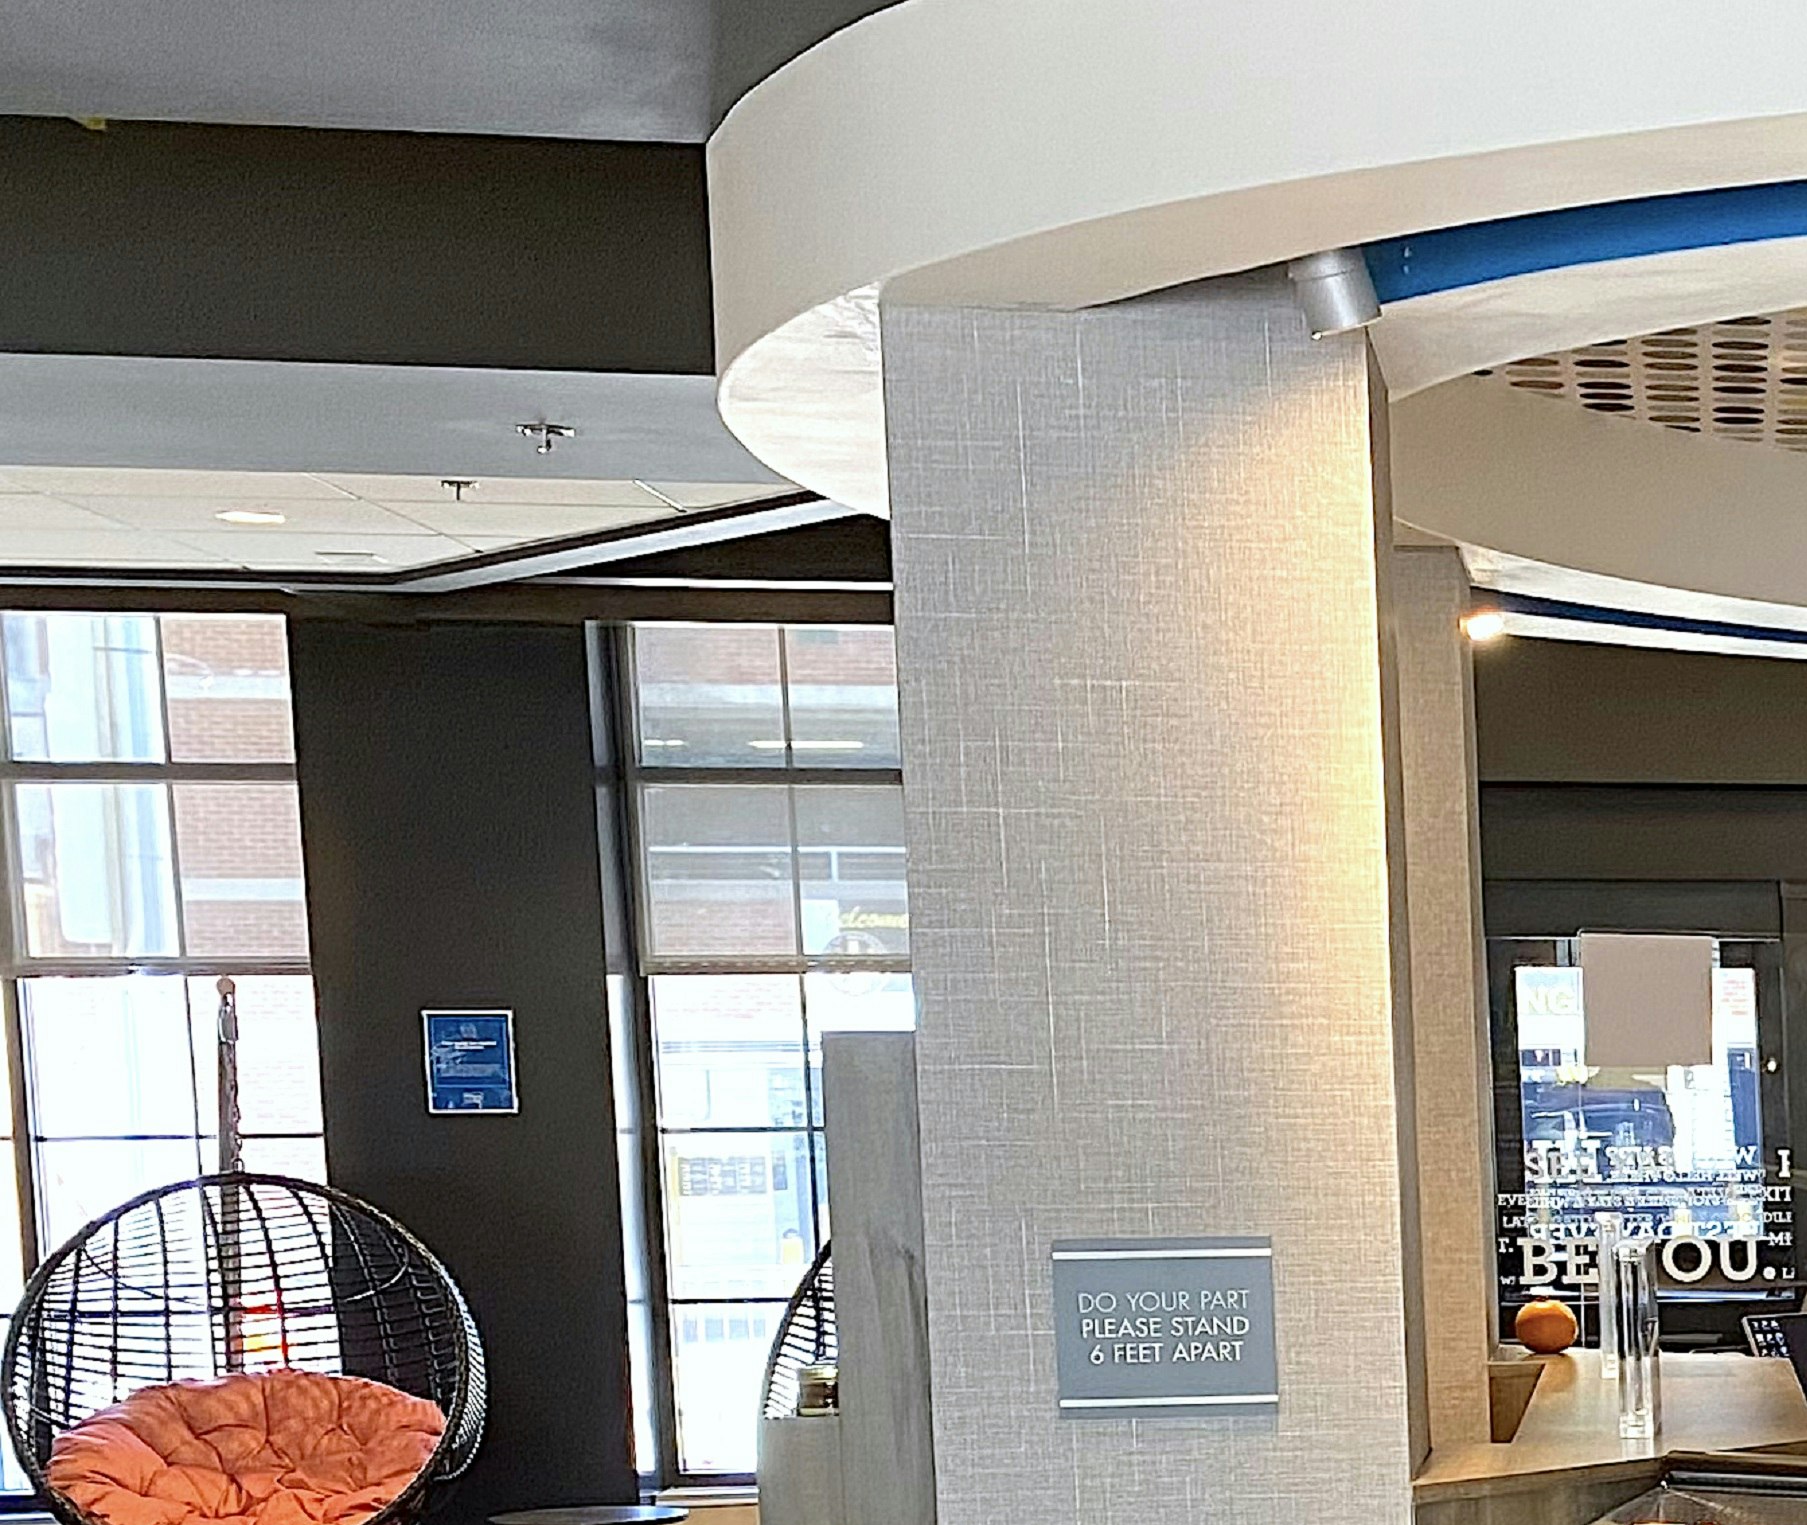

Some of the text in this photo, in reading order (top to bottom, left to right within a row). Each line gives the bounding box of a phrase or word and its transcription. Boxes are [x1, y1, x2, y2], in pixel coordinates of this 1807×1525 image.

[1518, 1236, 1600, 1286] BE
[1077, 1289, 1249, 1314] DO YOUR PART
[1081, 1316, 1250, 1339] PLEASE STAND
[1090, 1341, 1244, 1365] 6 FEET APART
